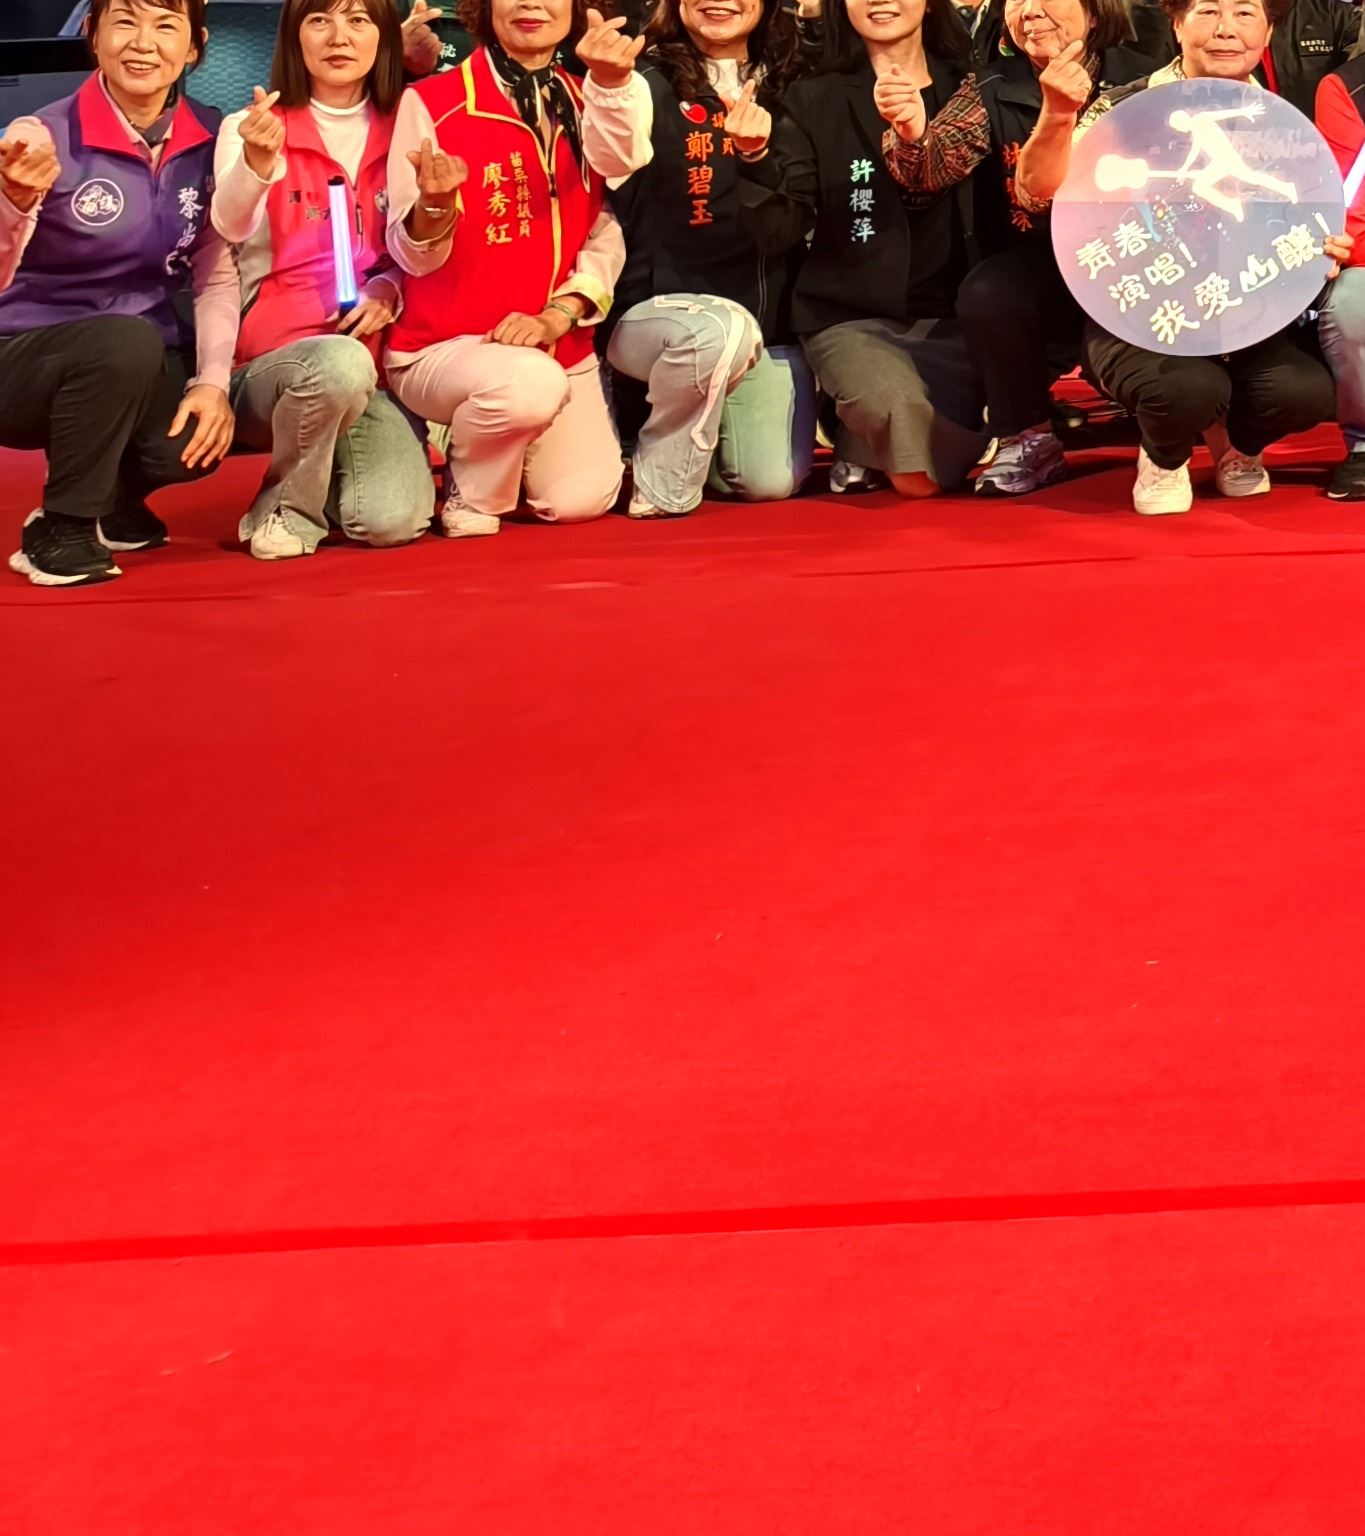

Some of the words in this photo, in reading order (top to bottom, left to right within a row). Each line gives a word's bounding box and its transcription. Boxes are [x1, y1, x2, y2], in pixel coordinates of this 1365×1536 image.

[481, 162, 513, 246] 廖秀紅
[509, 151, 534, 238] 苗栗縣議員
[684, 131, 714, 227] 鄭碧玉
[849, 157, 876, 243] 許櫻萍
[1075, 220, 1152, 280] 青春
[1108, 242, 1198, 313] 演唱!
